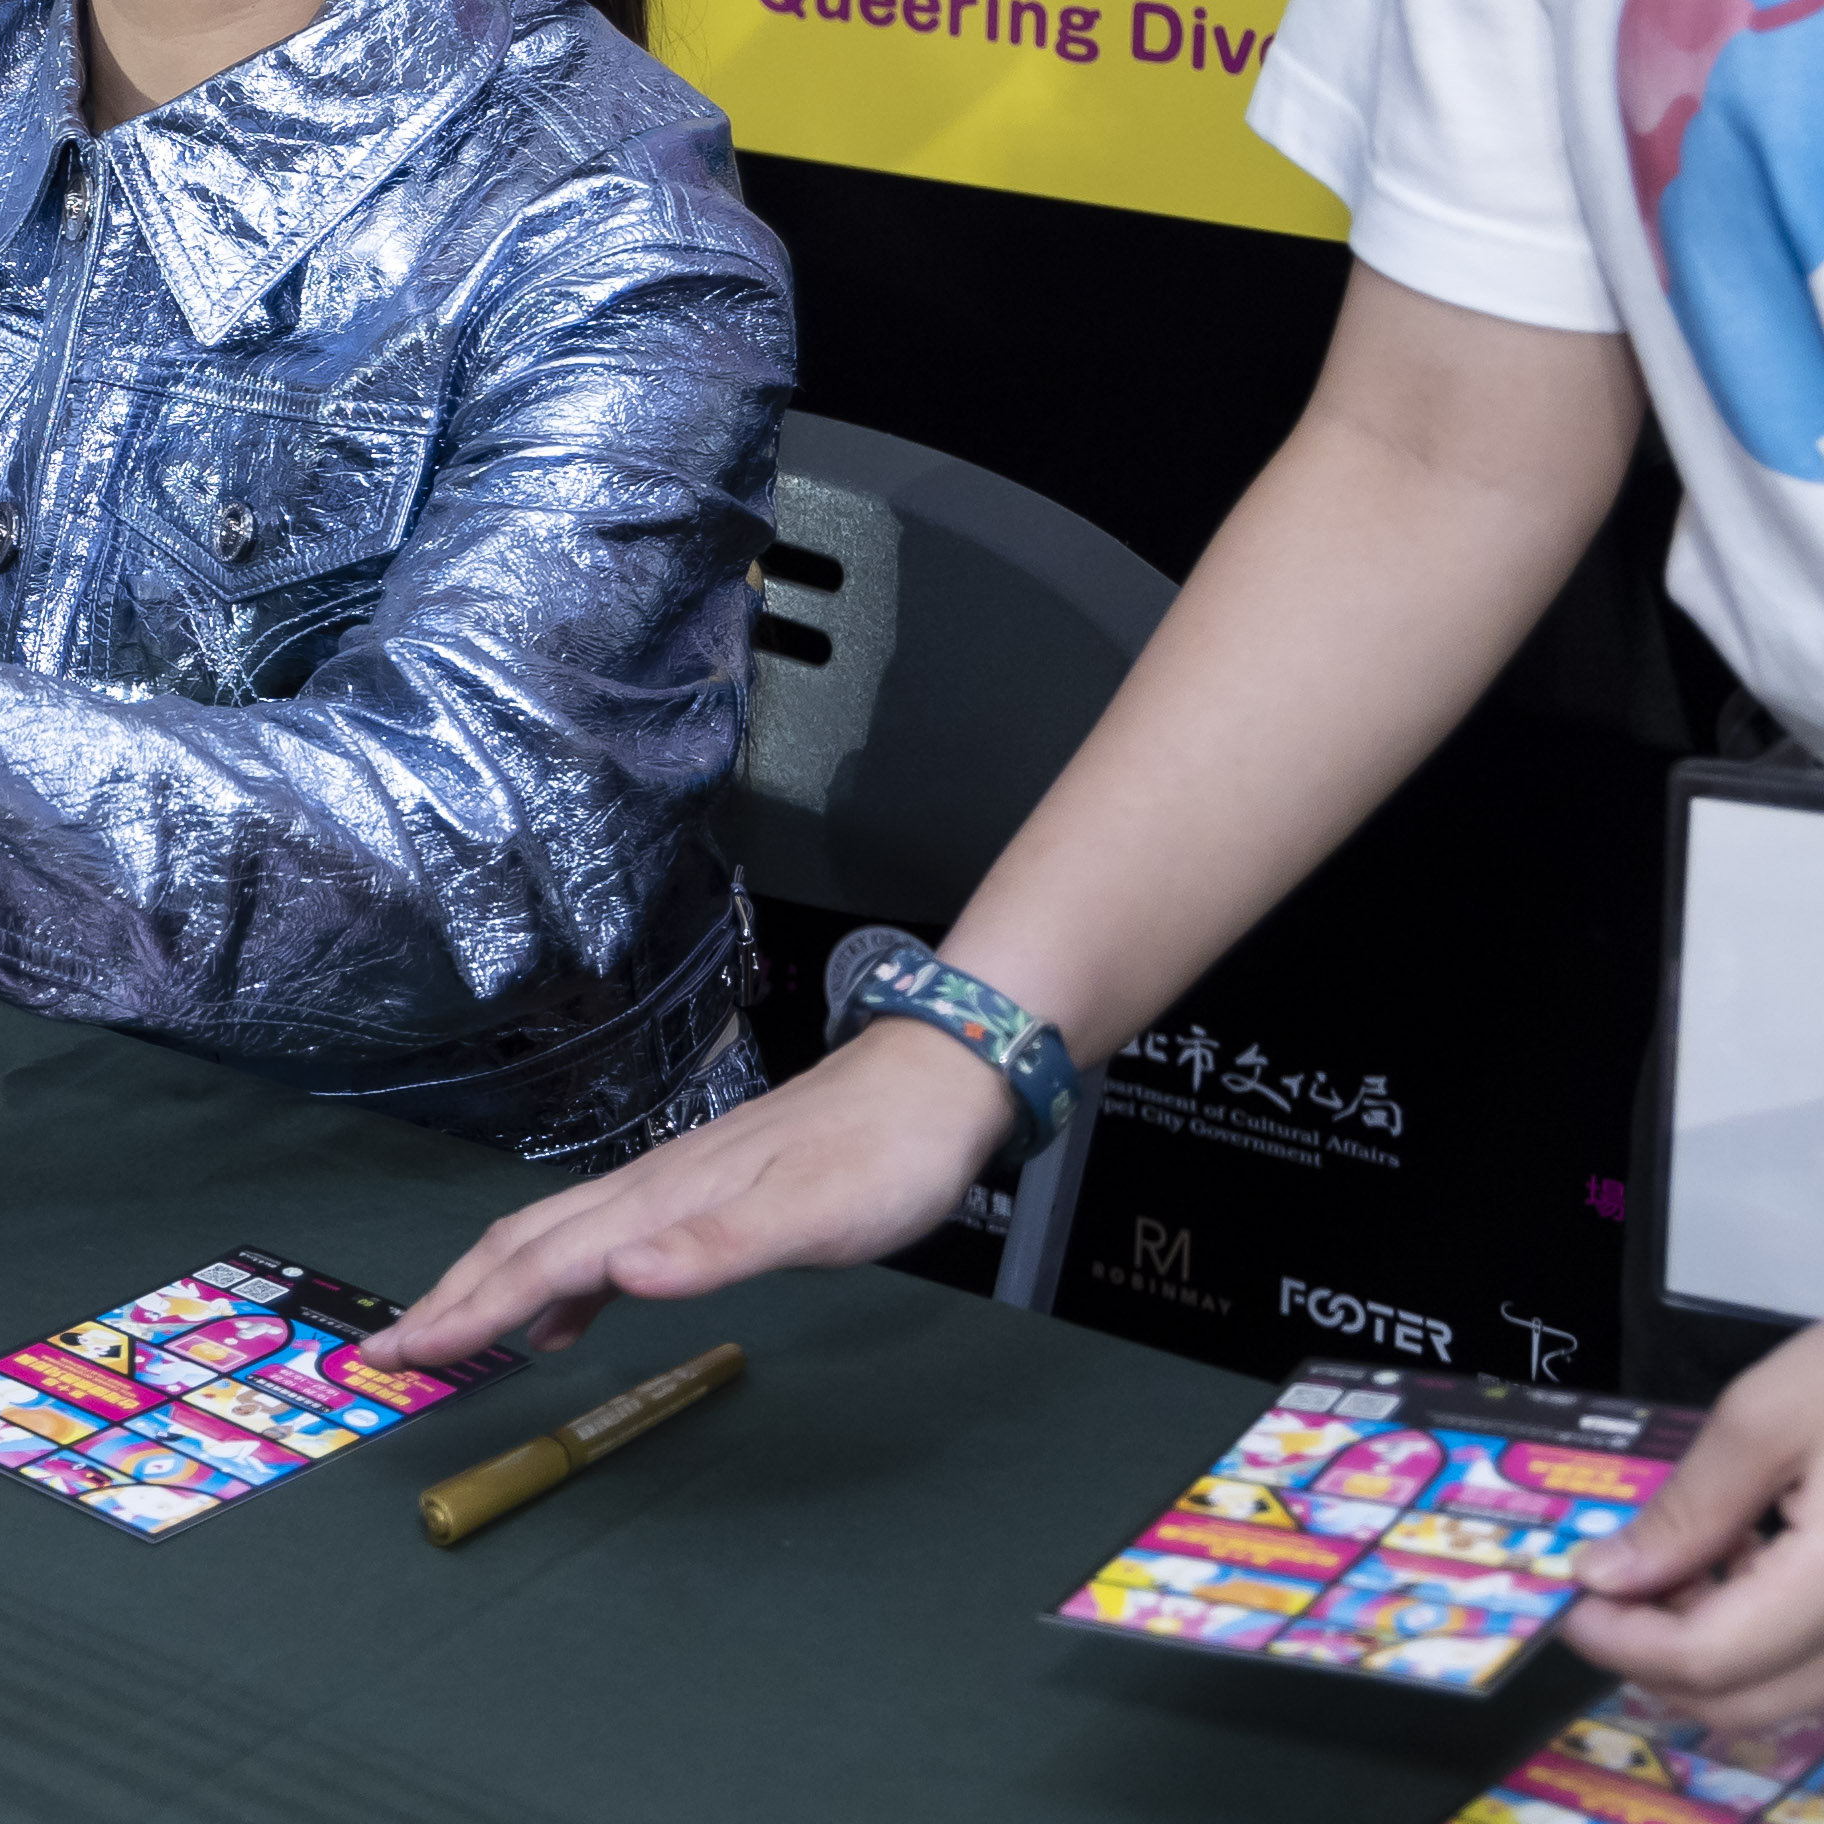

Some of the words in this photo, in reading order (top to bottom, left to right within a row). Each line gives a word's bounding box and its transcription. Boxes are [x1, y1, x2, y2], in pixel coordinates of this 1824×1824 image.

[1131, 0, 1276, 75] Div
[1140, 1102, 1186, 1134] City
[1188, 1115, 1323, 1170] Government
[1229, 1108, 1321, 1147] Cultural
[1325, 1134, 1402, 1169] Affairs
[1091, 1259, 1234, 1317] ROBINMAY
[1278, 1275, 1455, 1365] FOOTER
